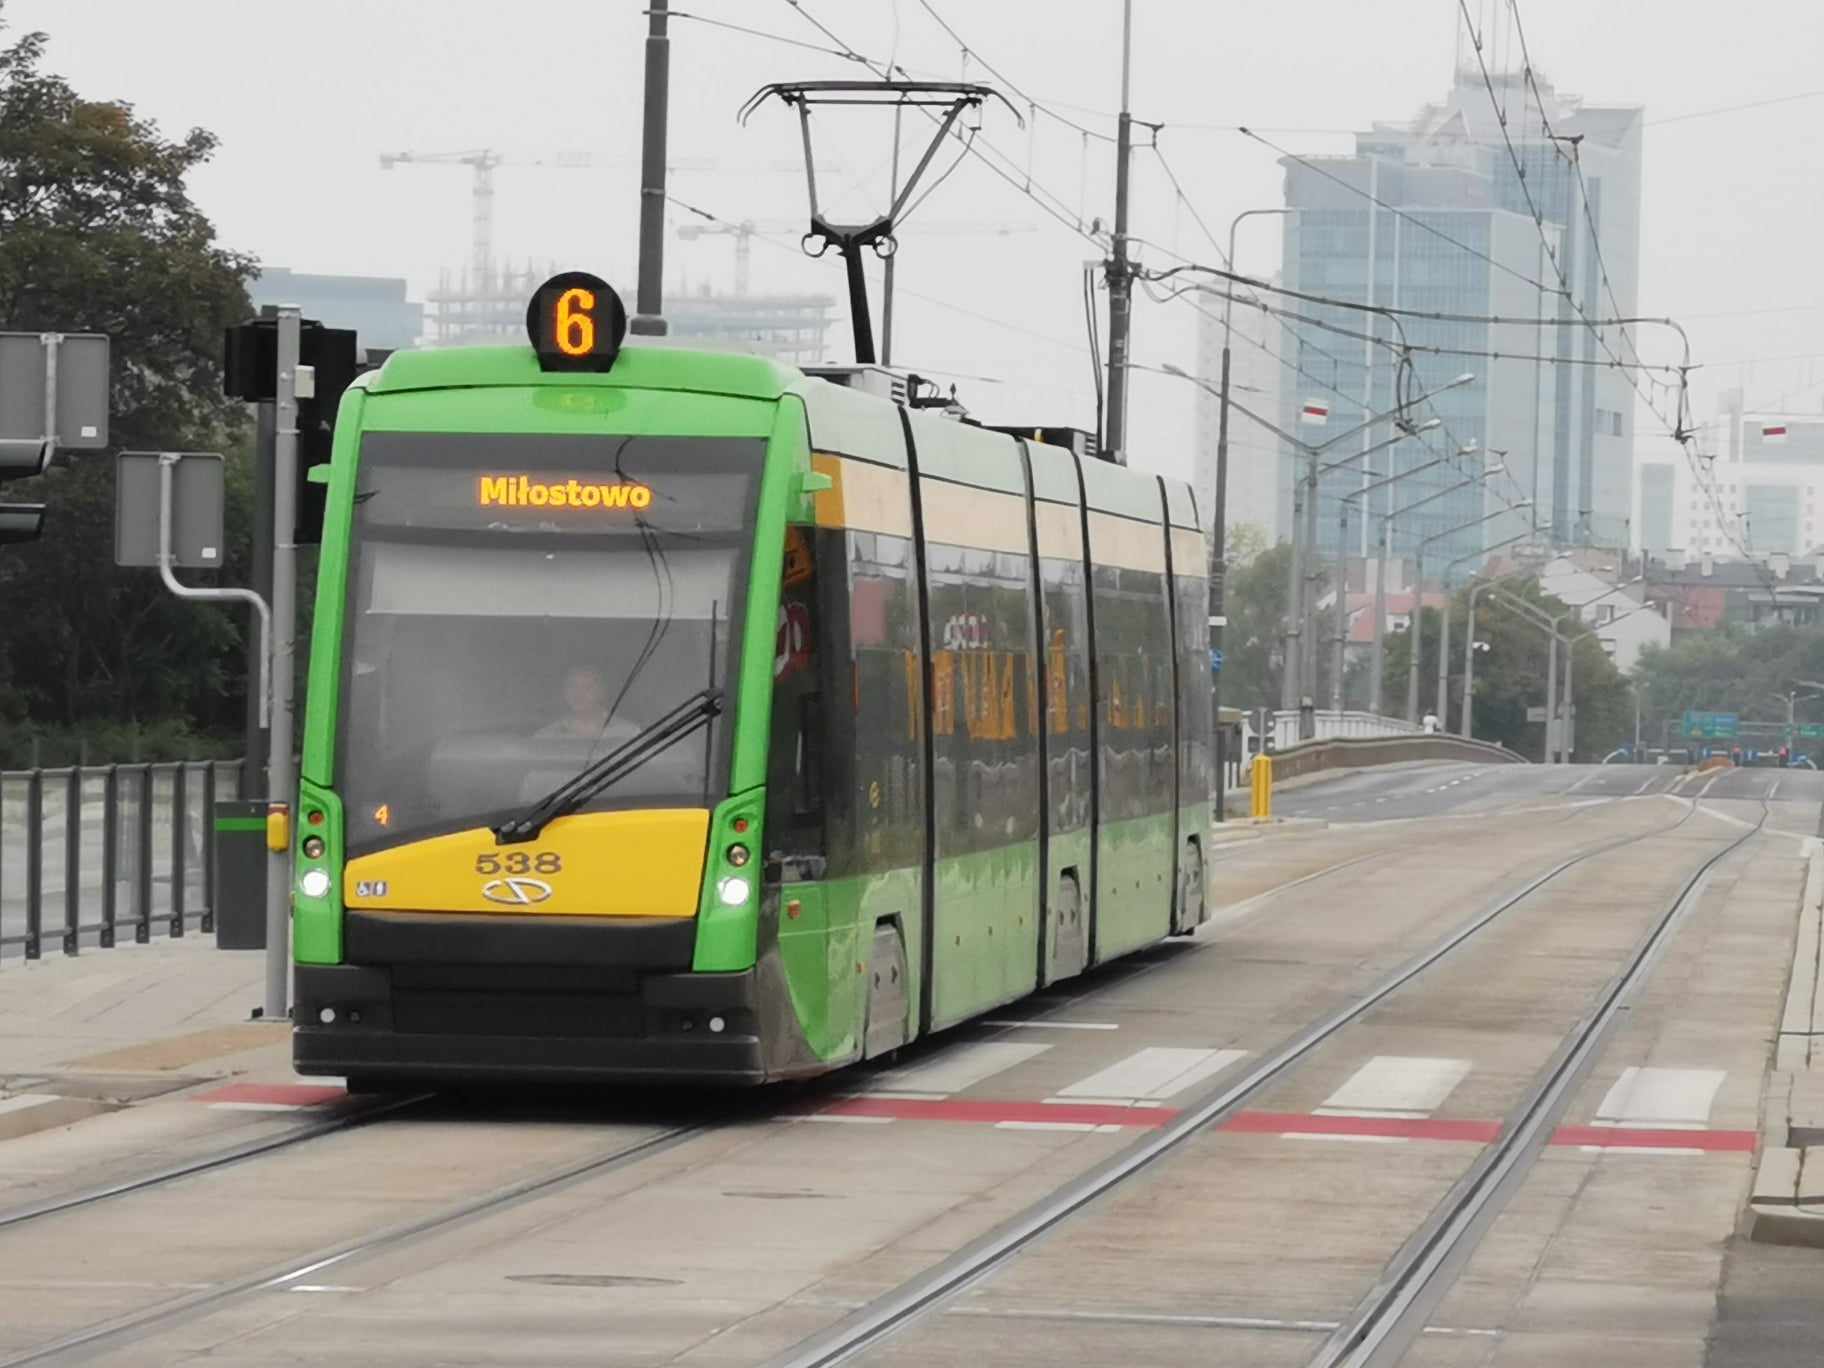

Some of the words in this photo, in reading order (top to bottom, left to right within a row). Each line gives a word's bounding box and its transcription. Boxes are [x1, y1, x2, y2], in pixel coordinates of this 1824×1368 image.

[556, 287, 595, 356] 6
[480, 475, 651, 508] Miłostowo
[374, 804, 391, 825] 4
[475, 851, 562, 875] 538
